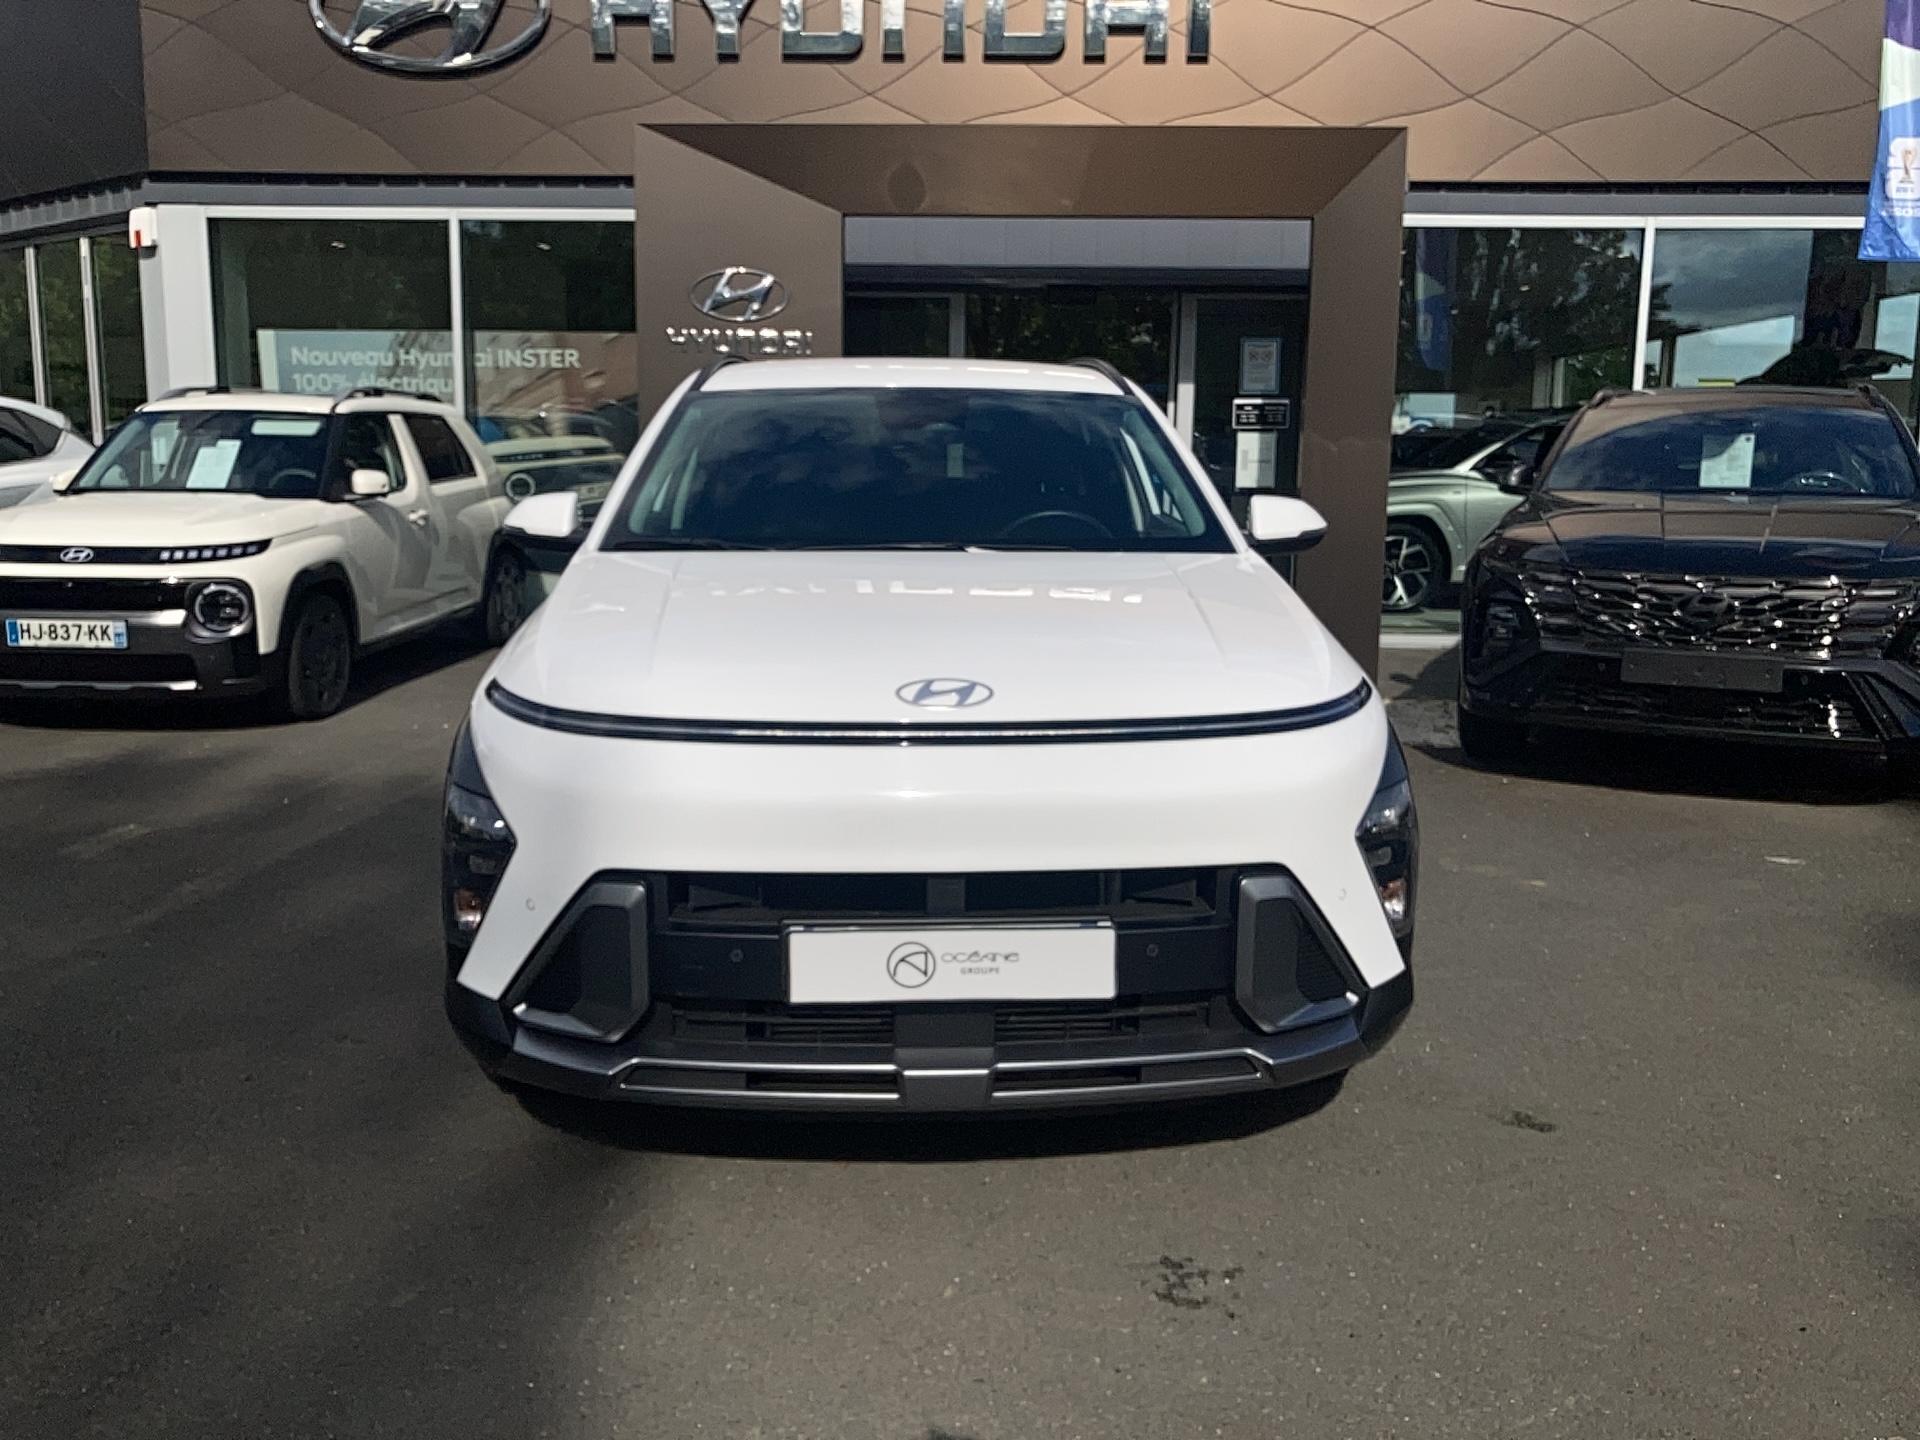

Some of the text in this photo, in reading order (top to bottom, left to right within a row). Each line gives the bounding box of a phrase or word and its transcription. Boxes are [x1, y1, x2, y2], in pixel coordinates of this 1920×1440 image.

[290, 347, 581, 370] Nouveau Hyunai INSTER
